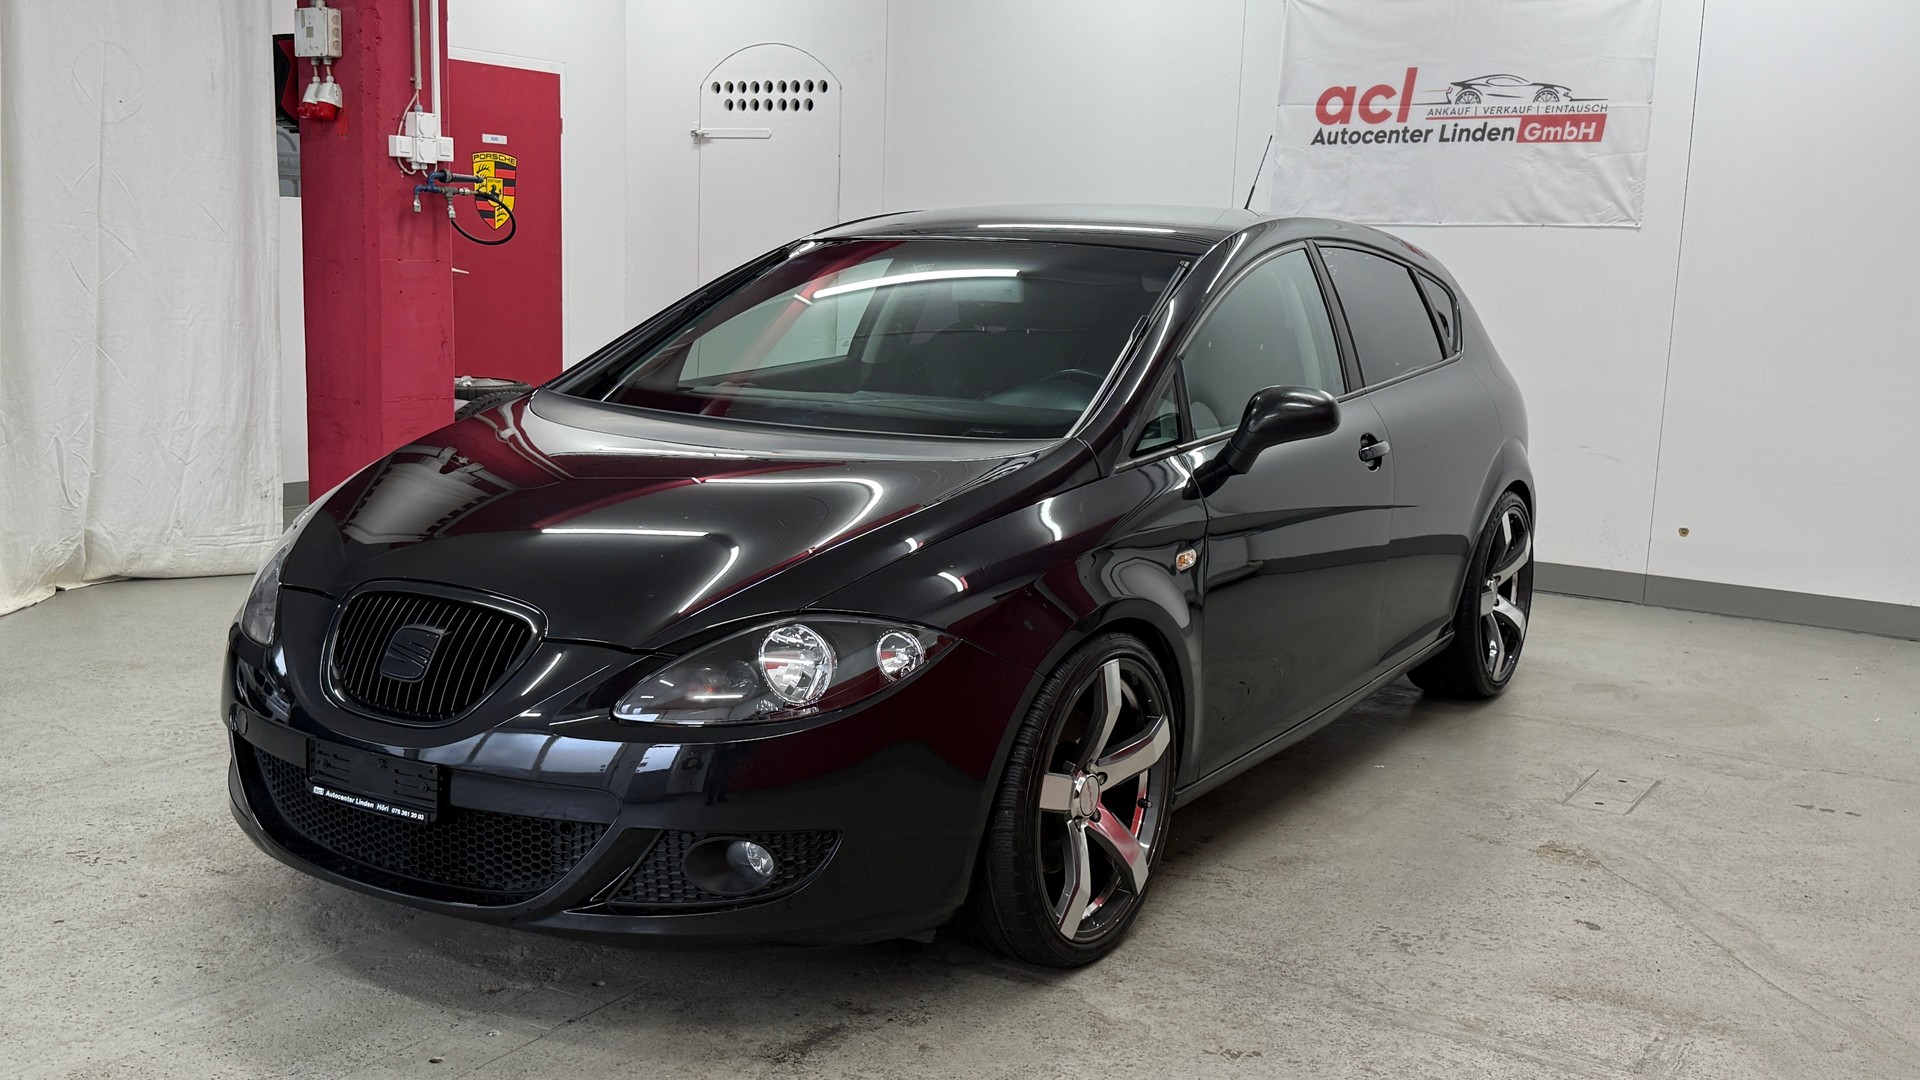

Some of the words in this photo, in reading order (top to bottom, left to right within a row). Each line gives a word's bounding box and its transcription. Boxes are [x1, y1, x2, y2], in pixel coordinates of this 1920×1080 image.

[1315, 67, 1419, 126] acl
[1427, 107, 1471, 117] ANKAUF
[1483, 105, 1533, 115] VERKAUF
[1545, 103, 1609, 114] EINTAUSCH
[1310, 125, 1434, 145] Autocenter
[1438, 122, 1515, 143] Linden
[1523, 122, 1595, 141] GmbH
[473, 153, 516, 165] PORSCHE
[326, 790, 355, 803] Autocenter
[355, 798, 375, 808] Linden
